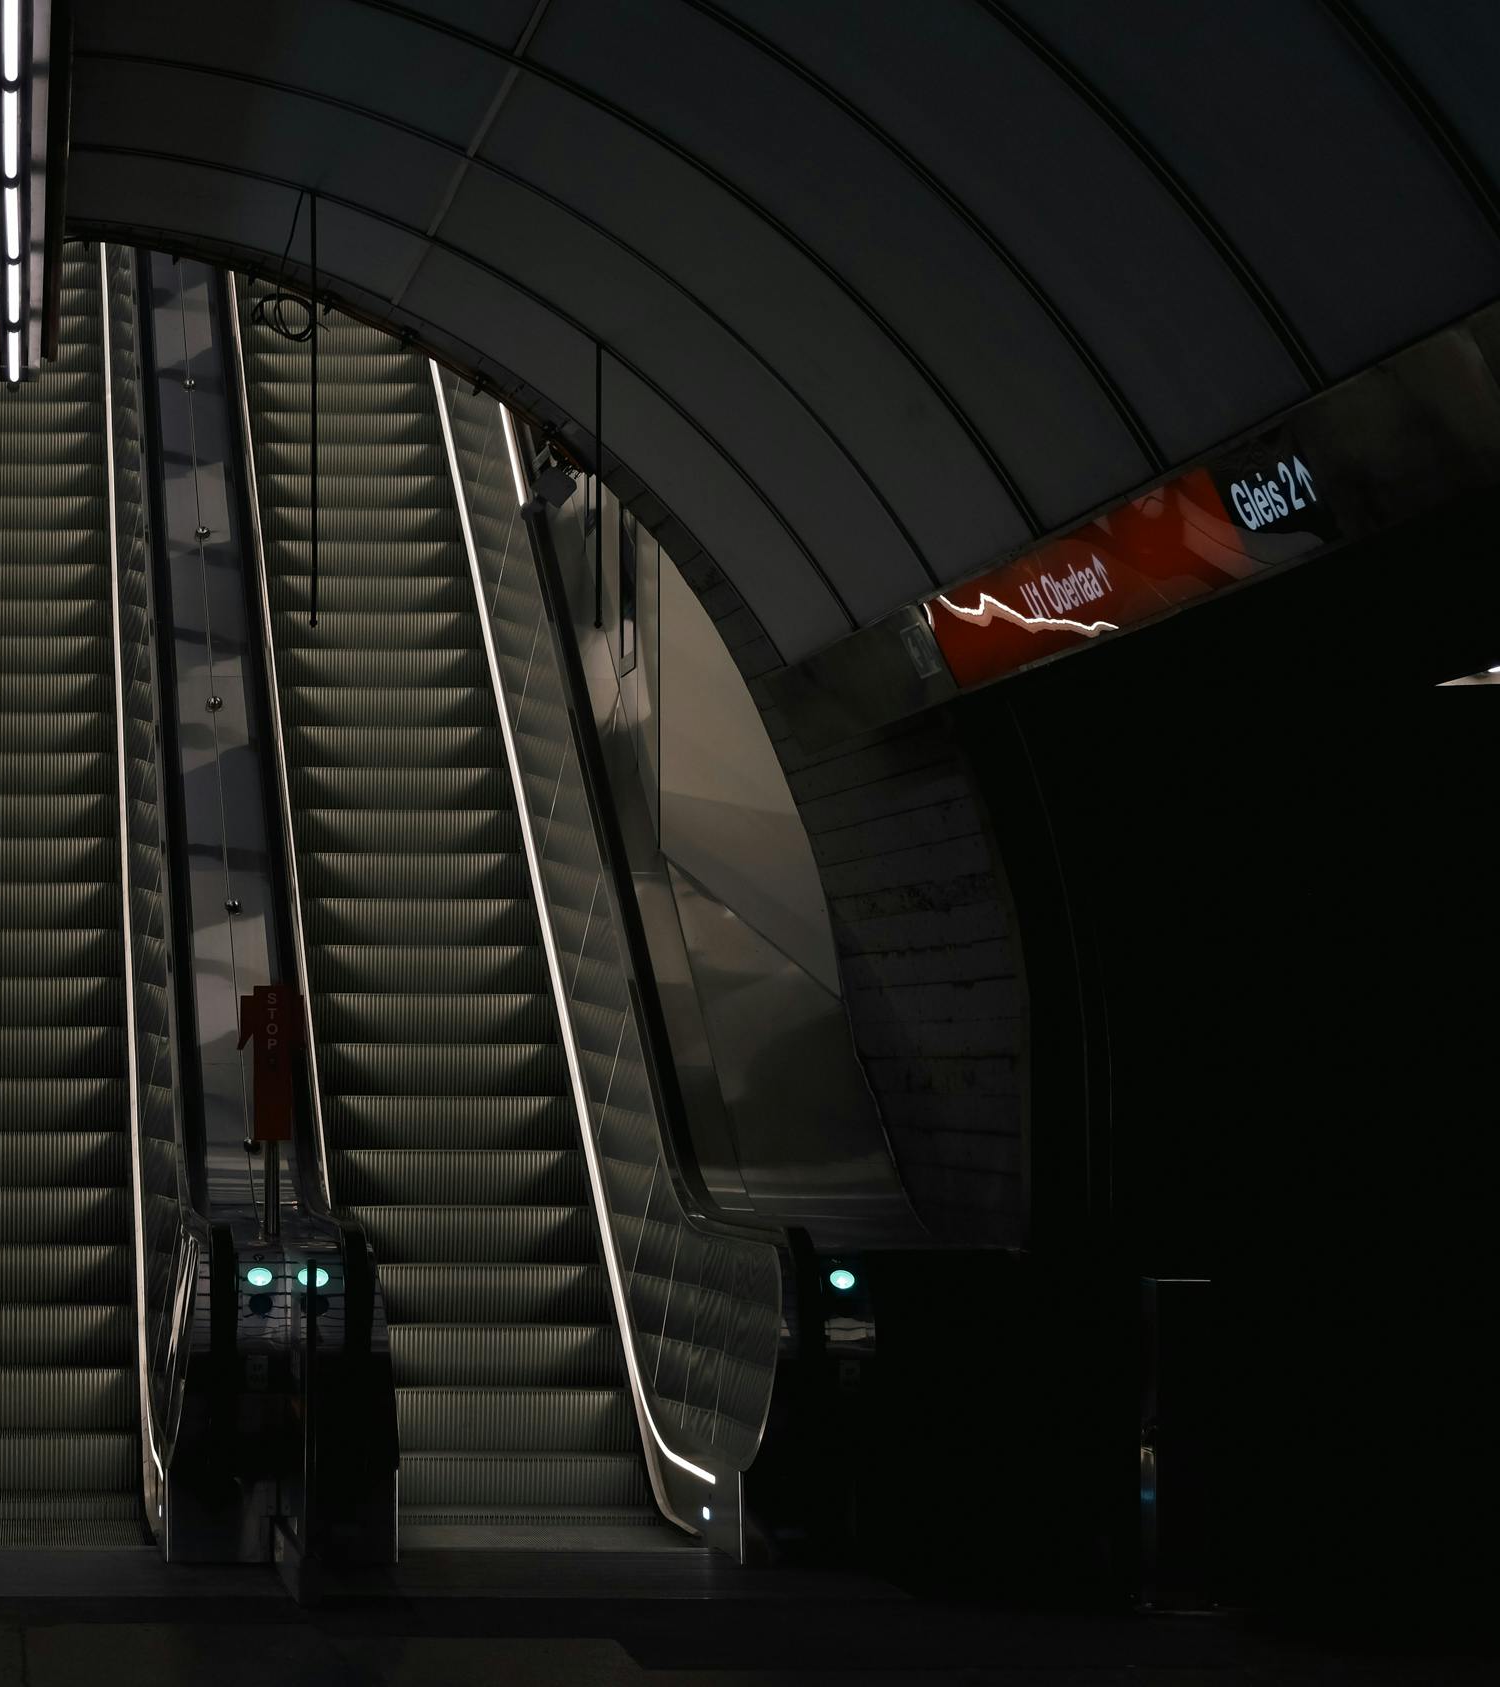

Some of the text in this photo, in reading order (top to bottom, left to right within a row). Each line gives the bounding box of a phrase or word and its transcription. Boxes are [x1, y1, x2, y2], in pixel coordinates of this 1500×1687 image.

[1230, 461, 1306, 531] Gleis 2
[1019, 563, 1105, 619] U1 Oberlaa
[266, 993, 278, 1050] STOP
